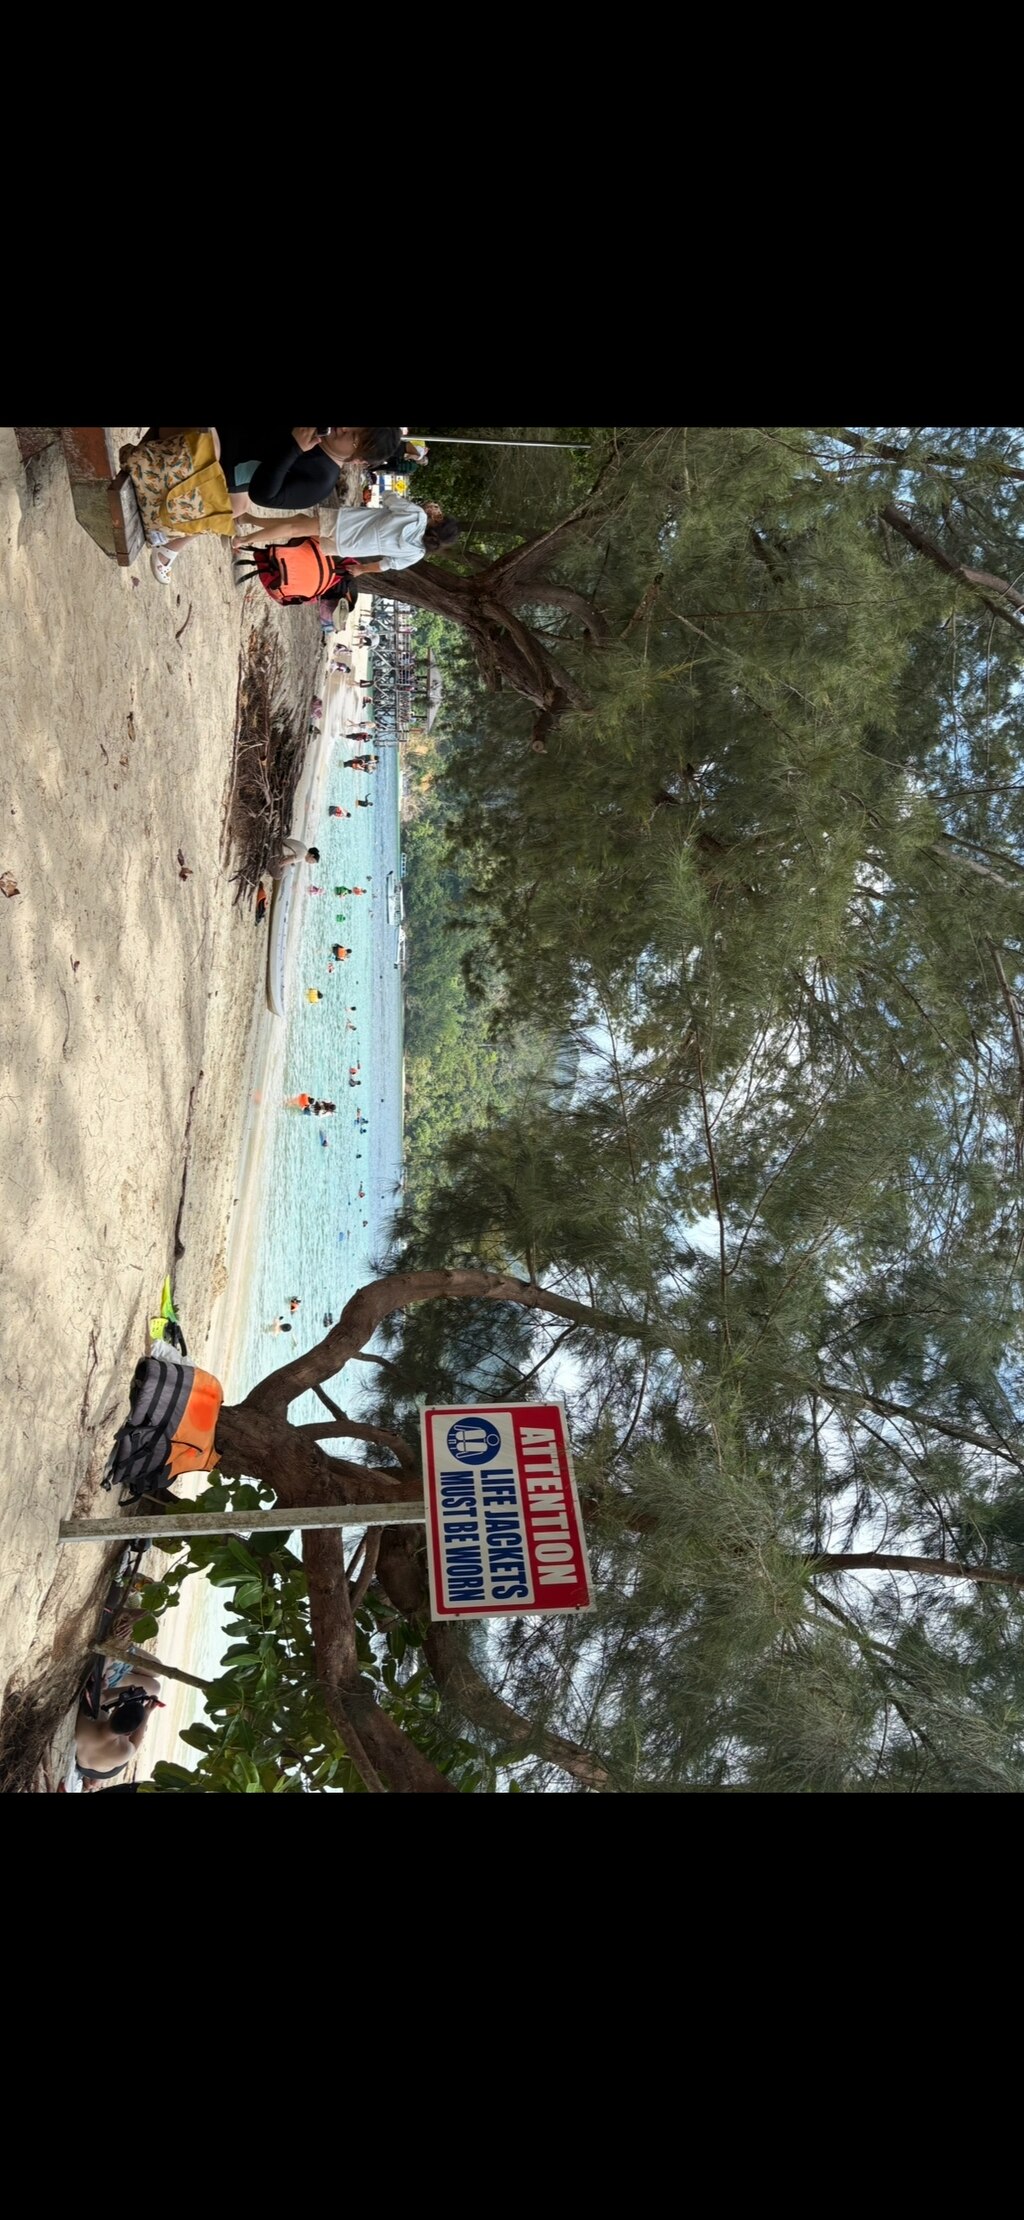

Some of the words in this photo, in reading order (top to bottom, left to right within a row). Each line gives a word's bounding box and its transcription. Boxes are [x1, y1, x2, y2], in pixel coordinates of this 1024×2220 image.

[440, 1471, 478, 1517] MUST
[480, 1469, 516, 1506] LIFE
[519, 1427, 578, 1585] ATTENTION
[443, 1521, 479, 1543] BE
[484, 1510, 528, 1600] JACKETS
[444, 1545, 485, 1601] WORN
